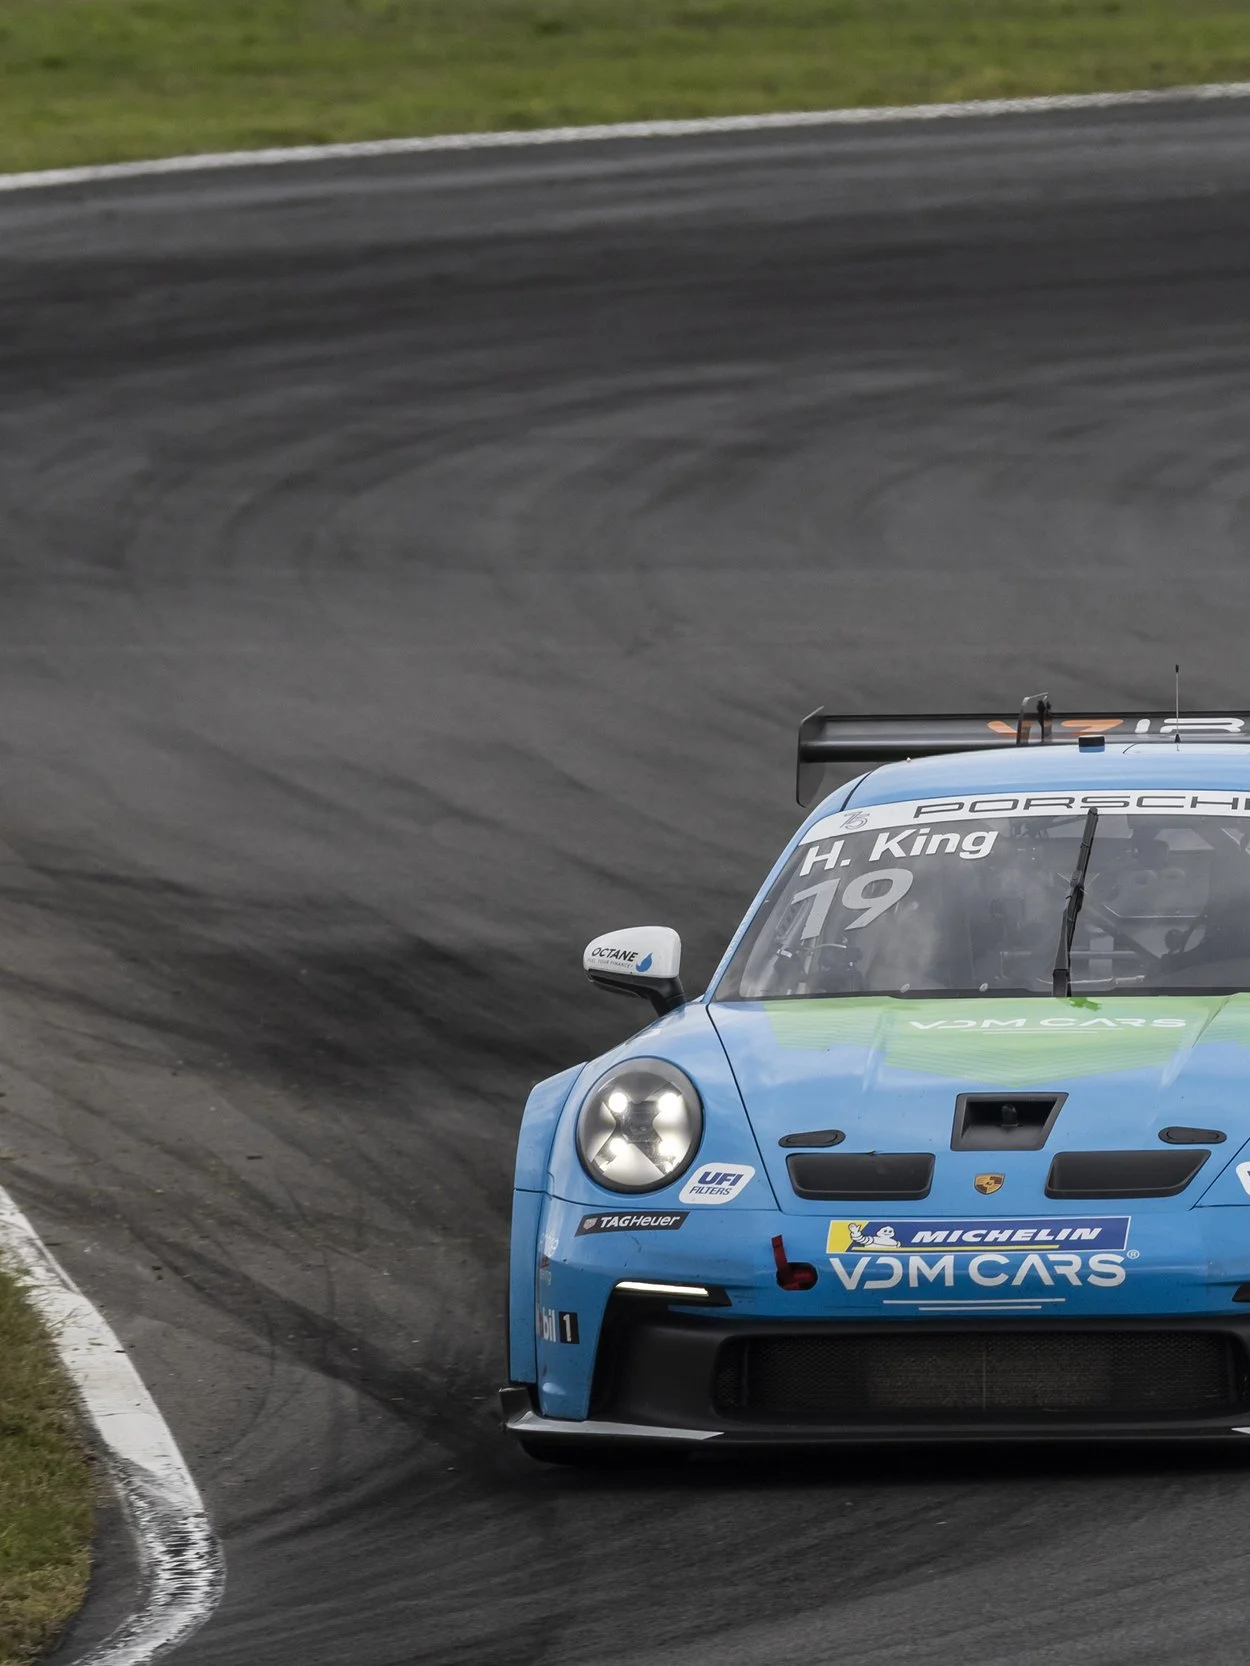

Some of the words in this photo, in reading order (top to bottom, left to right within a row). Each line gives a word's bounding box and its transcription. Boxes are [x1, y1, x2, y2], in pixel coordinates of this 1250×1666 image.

[799, 840, 851, 877] H.
[868, 827, 999, 860] King
[790, 868, 914, 941] 19
[591, 947, 639, 962] OCTANE
[1039, 1017, 1187, 1028] CARS
[697, 1171, 745, 1187] UFI
[689, 1185, 732, 1196] FILTERS
[911, 1226, 1103, 1244] MICHELIN
[829, 1254, 954, 1290] VDM
[562, 1313, 572, 1342] 1
